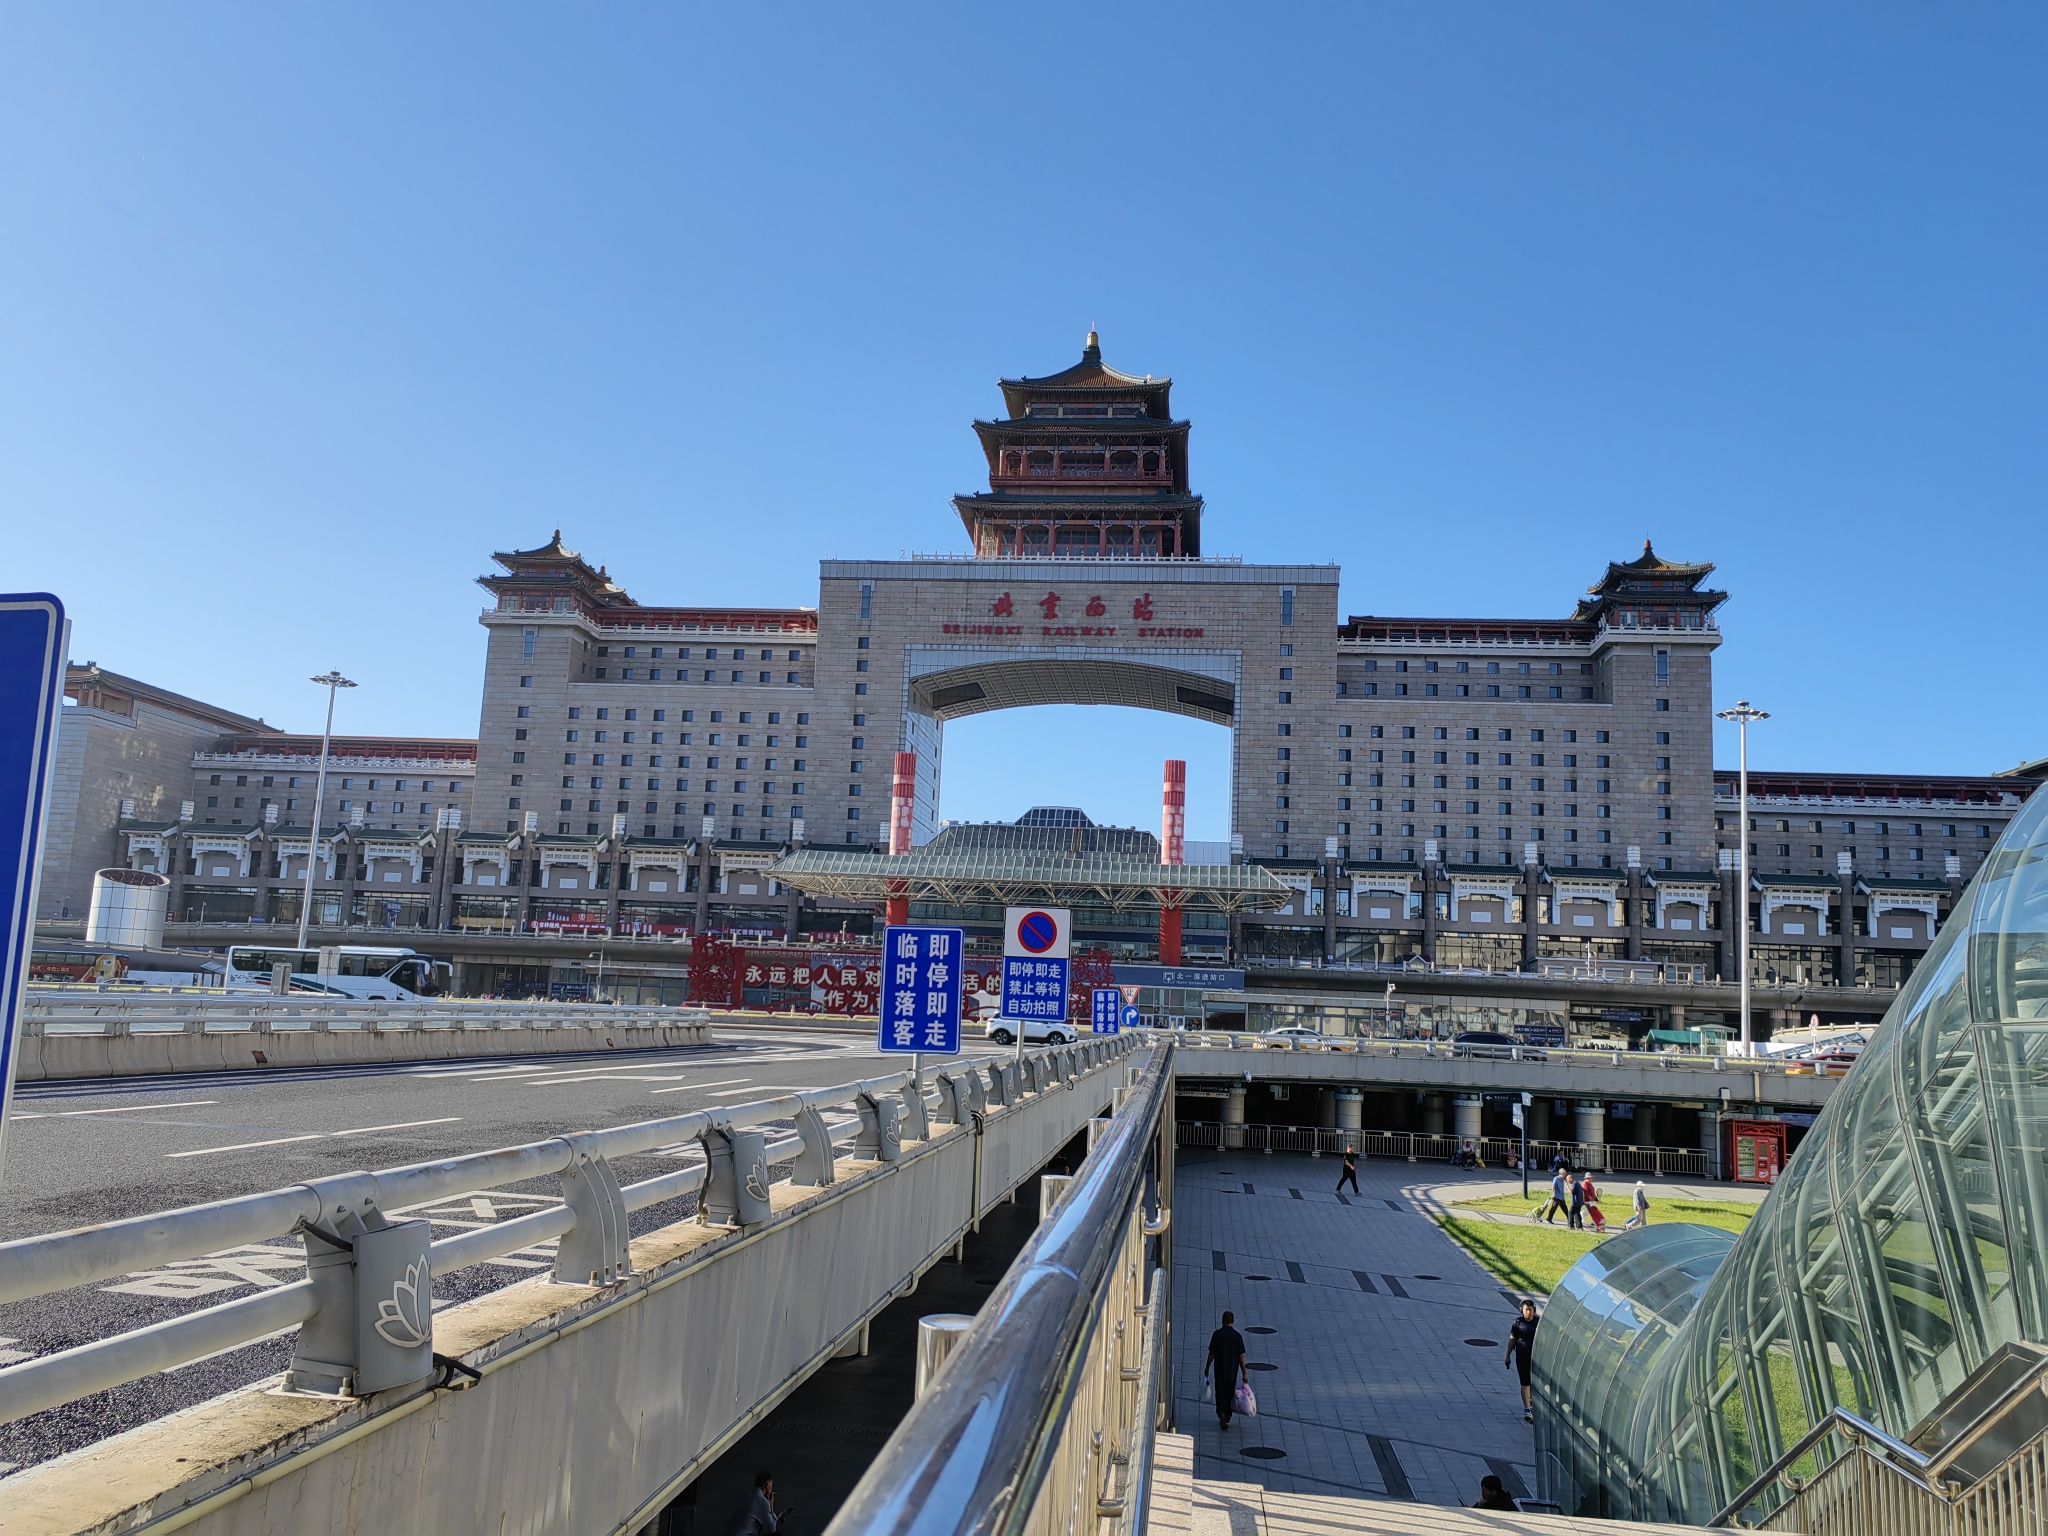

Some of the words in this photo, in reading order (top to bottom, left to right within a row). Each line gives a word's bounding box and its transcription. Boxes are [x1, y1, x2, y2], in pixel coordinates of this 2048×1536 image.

[993, 591, 1154, 621] 北京西站
[1042, 625, 1117, 637] RAILWAY
[1137, 626, 1205, 638] STATION
[745, 966, 881, 987] 永远把人民对
[1009, 961, 1061, 979] 即停即走
[893, 933, 918, 1046] 临时落客
[924, 934, 950, 1047] 即停即走
[1008, 979, 1061, 997] 禁止等待
[827, 989, 881, 1009] 作为
[1008, 998, 1060, 1016] 自动拍照
